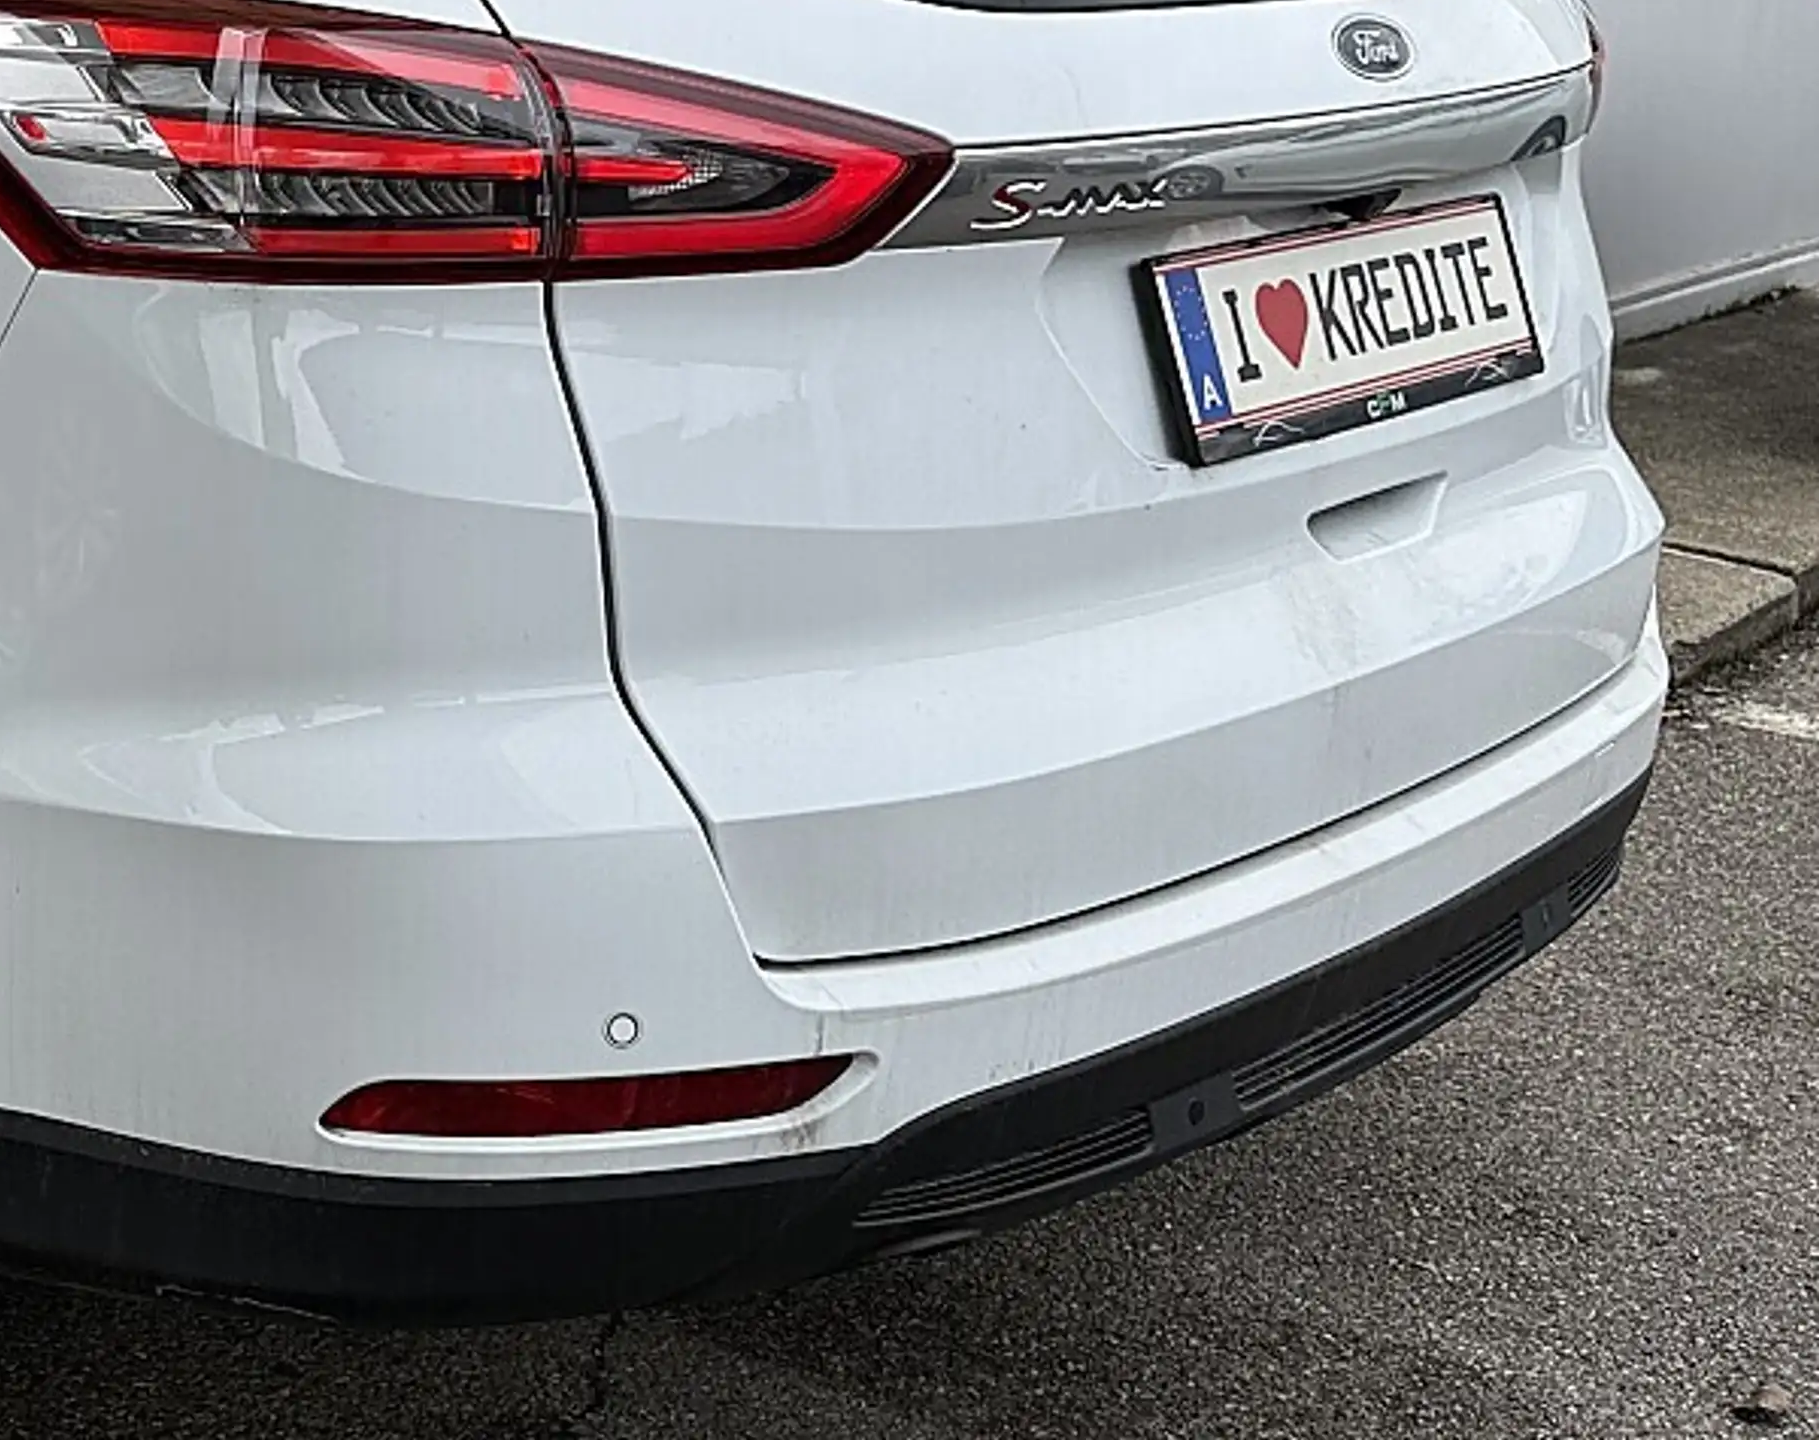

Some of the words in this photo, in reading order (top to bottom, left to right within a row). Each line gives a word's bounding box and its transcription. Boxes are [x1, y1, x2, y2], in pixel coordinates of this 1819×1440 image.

[1353, 30, 1399, 65] Ford
[1222, 289, 1262, 383] I
[1309, 236, 1508, 361] KREDITE
[1201, 373, 1223, 411] A
